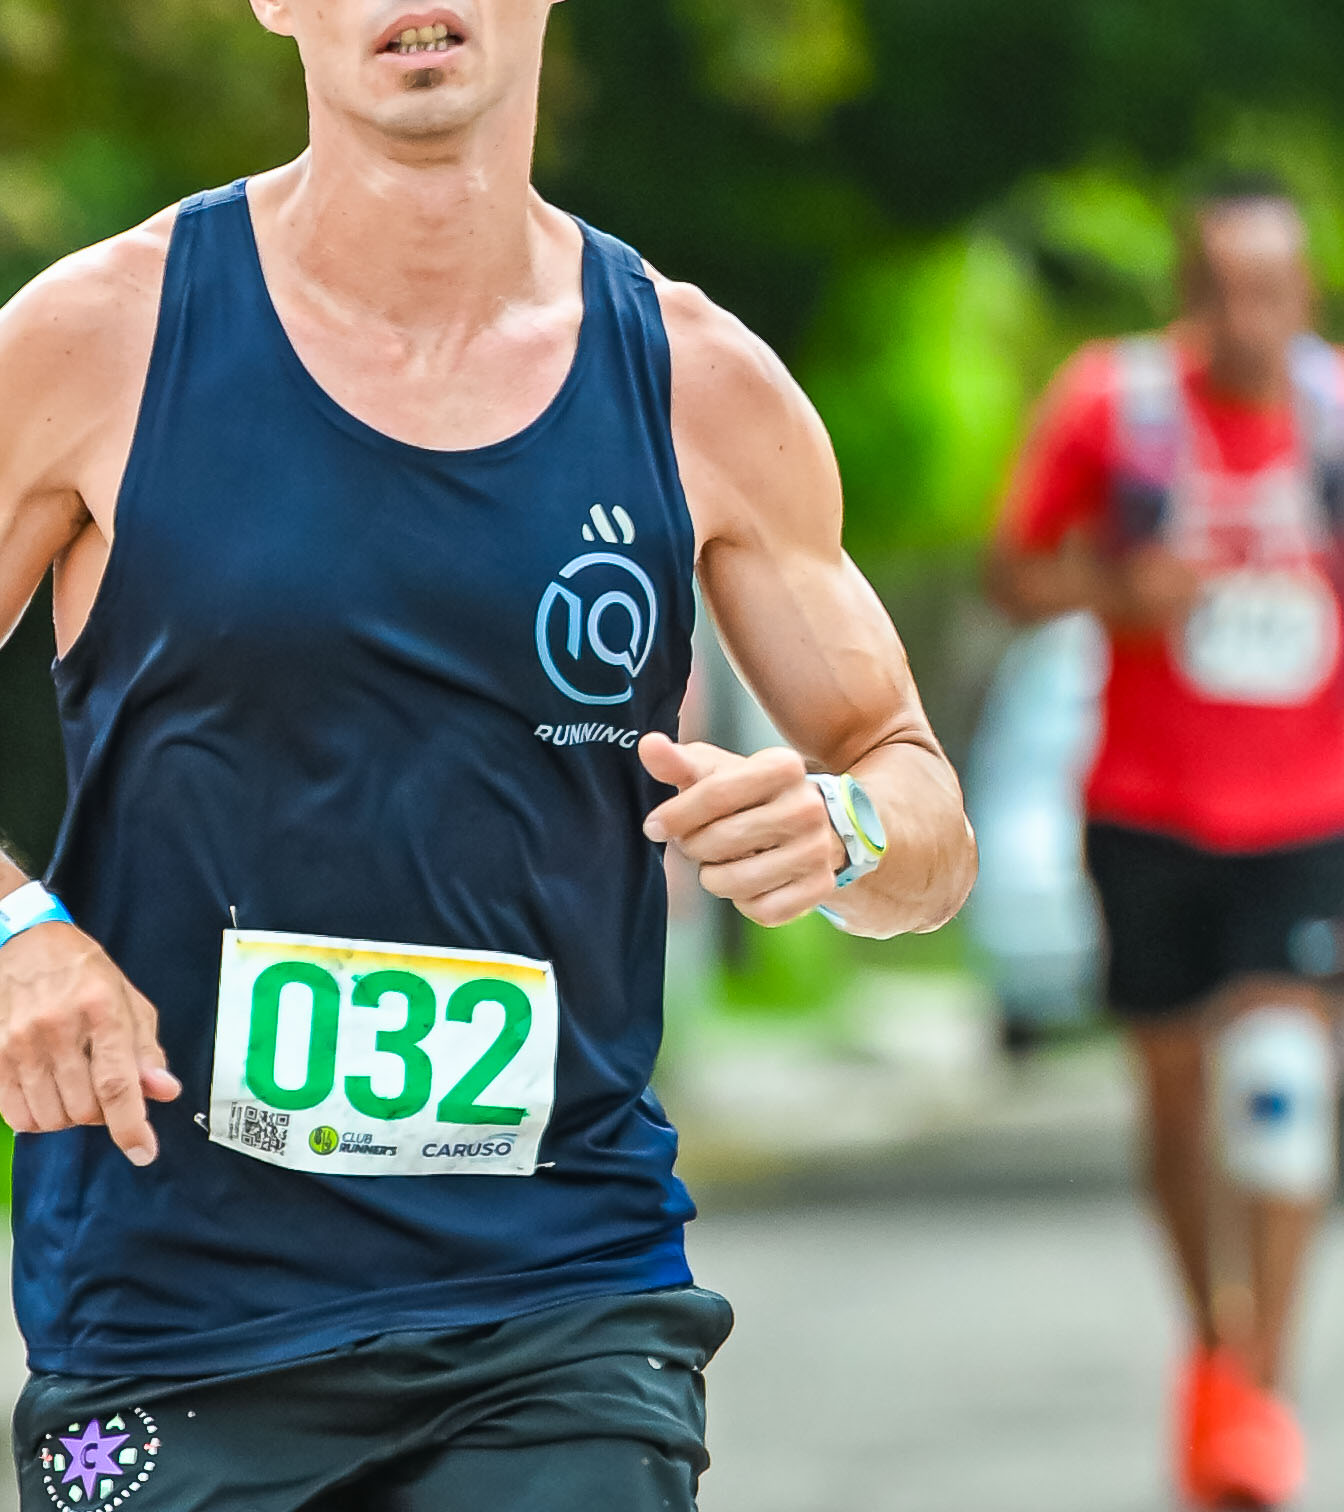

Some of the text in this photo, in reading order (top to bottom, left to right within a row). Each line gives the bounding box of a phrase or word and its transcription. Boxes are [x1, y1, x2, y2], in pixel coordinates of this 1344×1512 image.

[534, 723, 638, 749] RUNNING
[245, 961, 532, 1126] 032
[342, 1131, 373, 1145] CLUB
[421, 1141, 512, 1158] CARUSO
